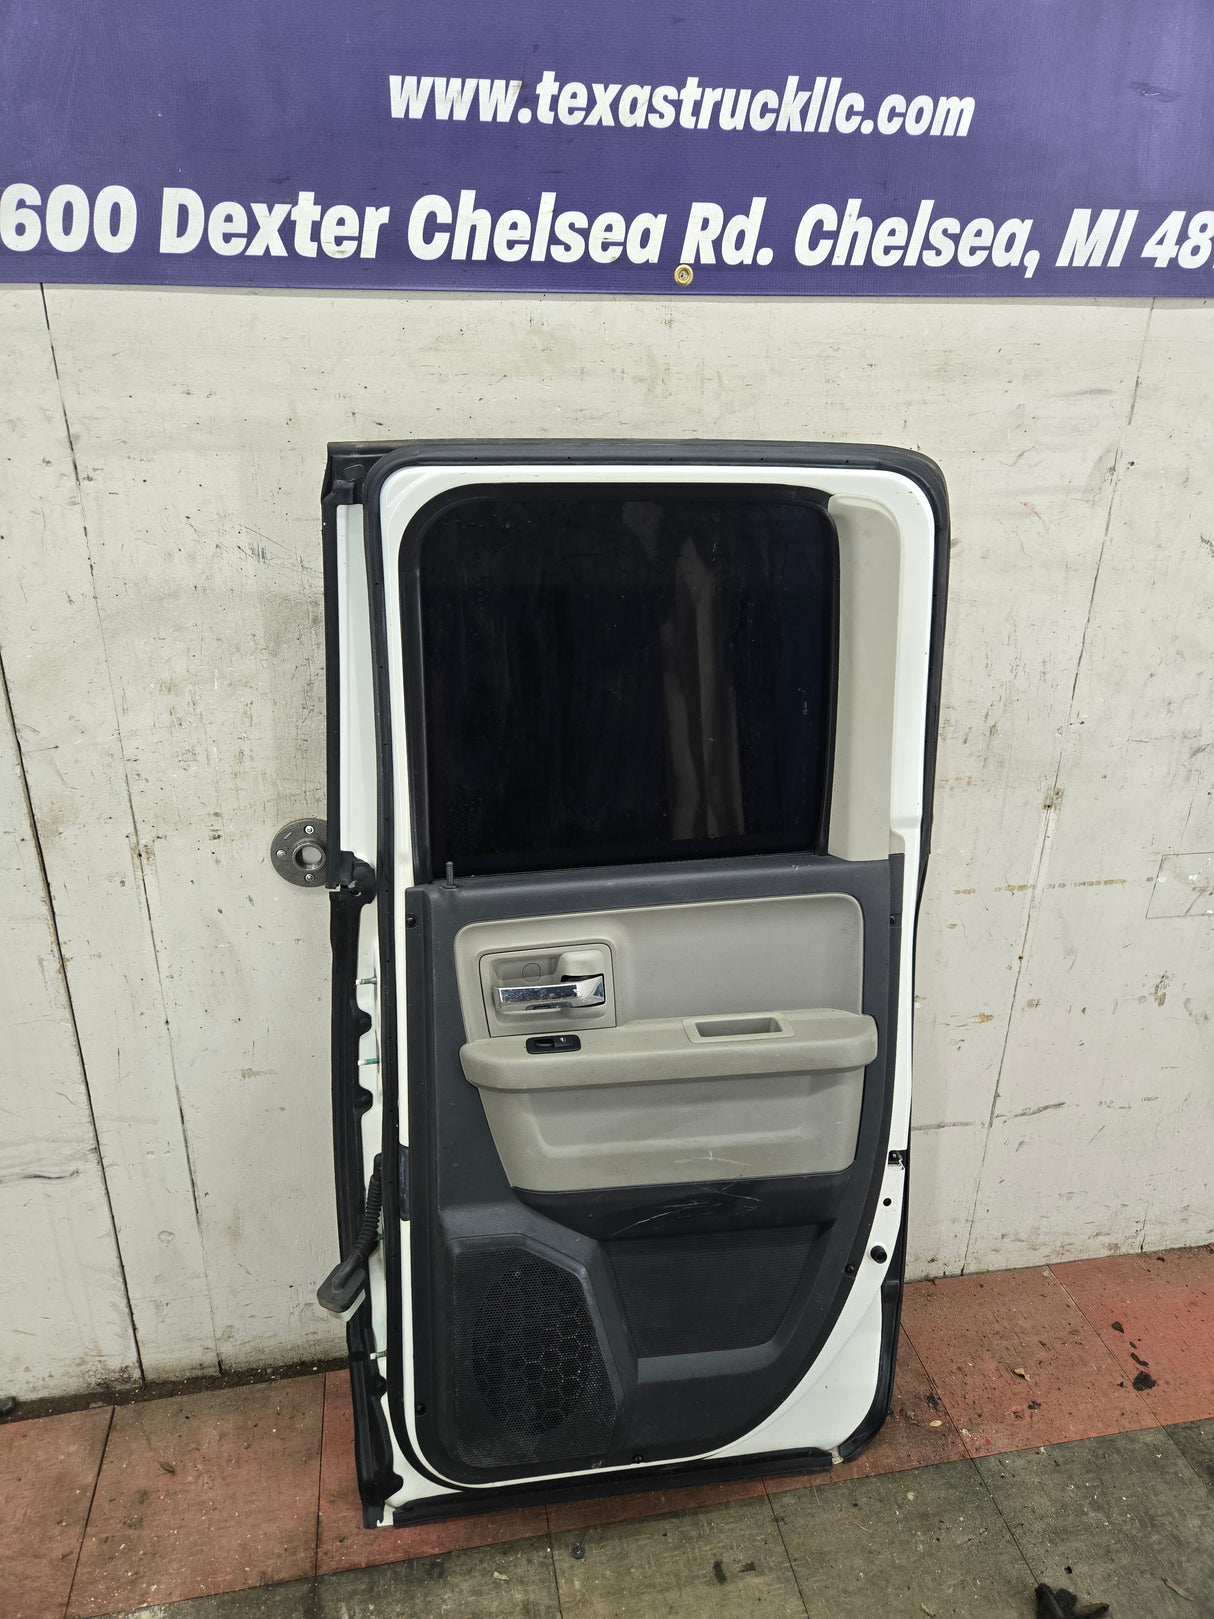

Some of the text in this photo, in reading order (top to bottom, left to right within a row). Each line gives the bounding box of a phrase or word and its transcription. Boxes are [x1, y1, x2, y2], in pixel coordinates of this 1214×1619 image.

[389, 71, 975, 137] www.texastruckllc.com
[0, 183, 1214, 279] 600 Dexter Chelsea Rd. Chelsea, MI 48
